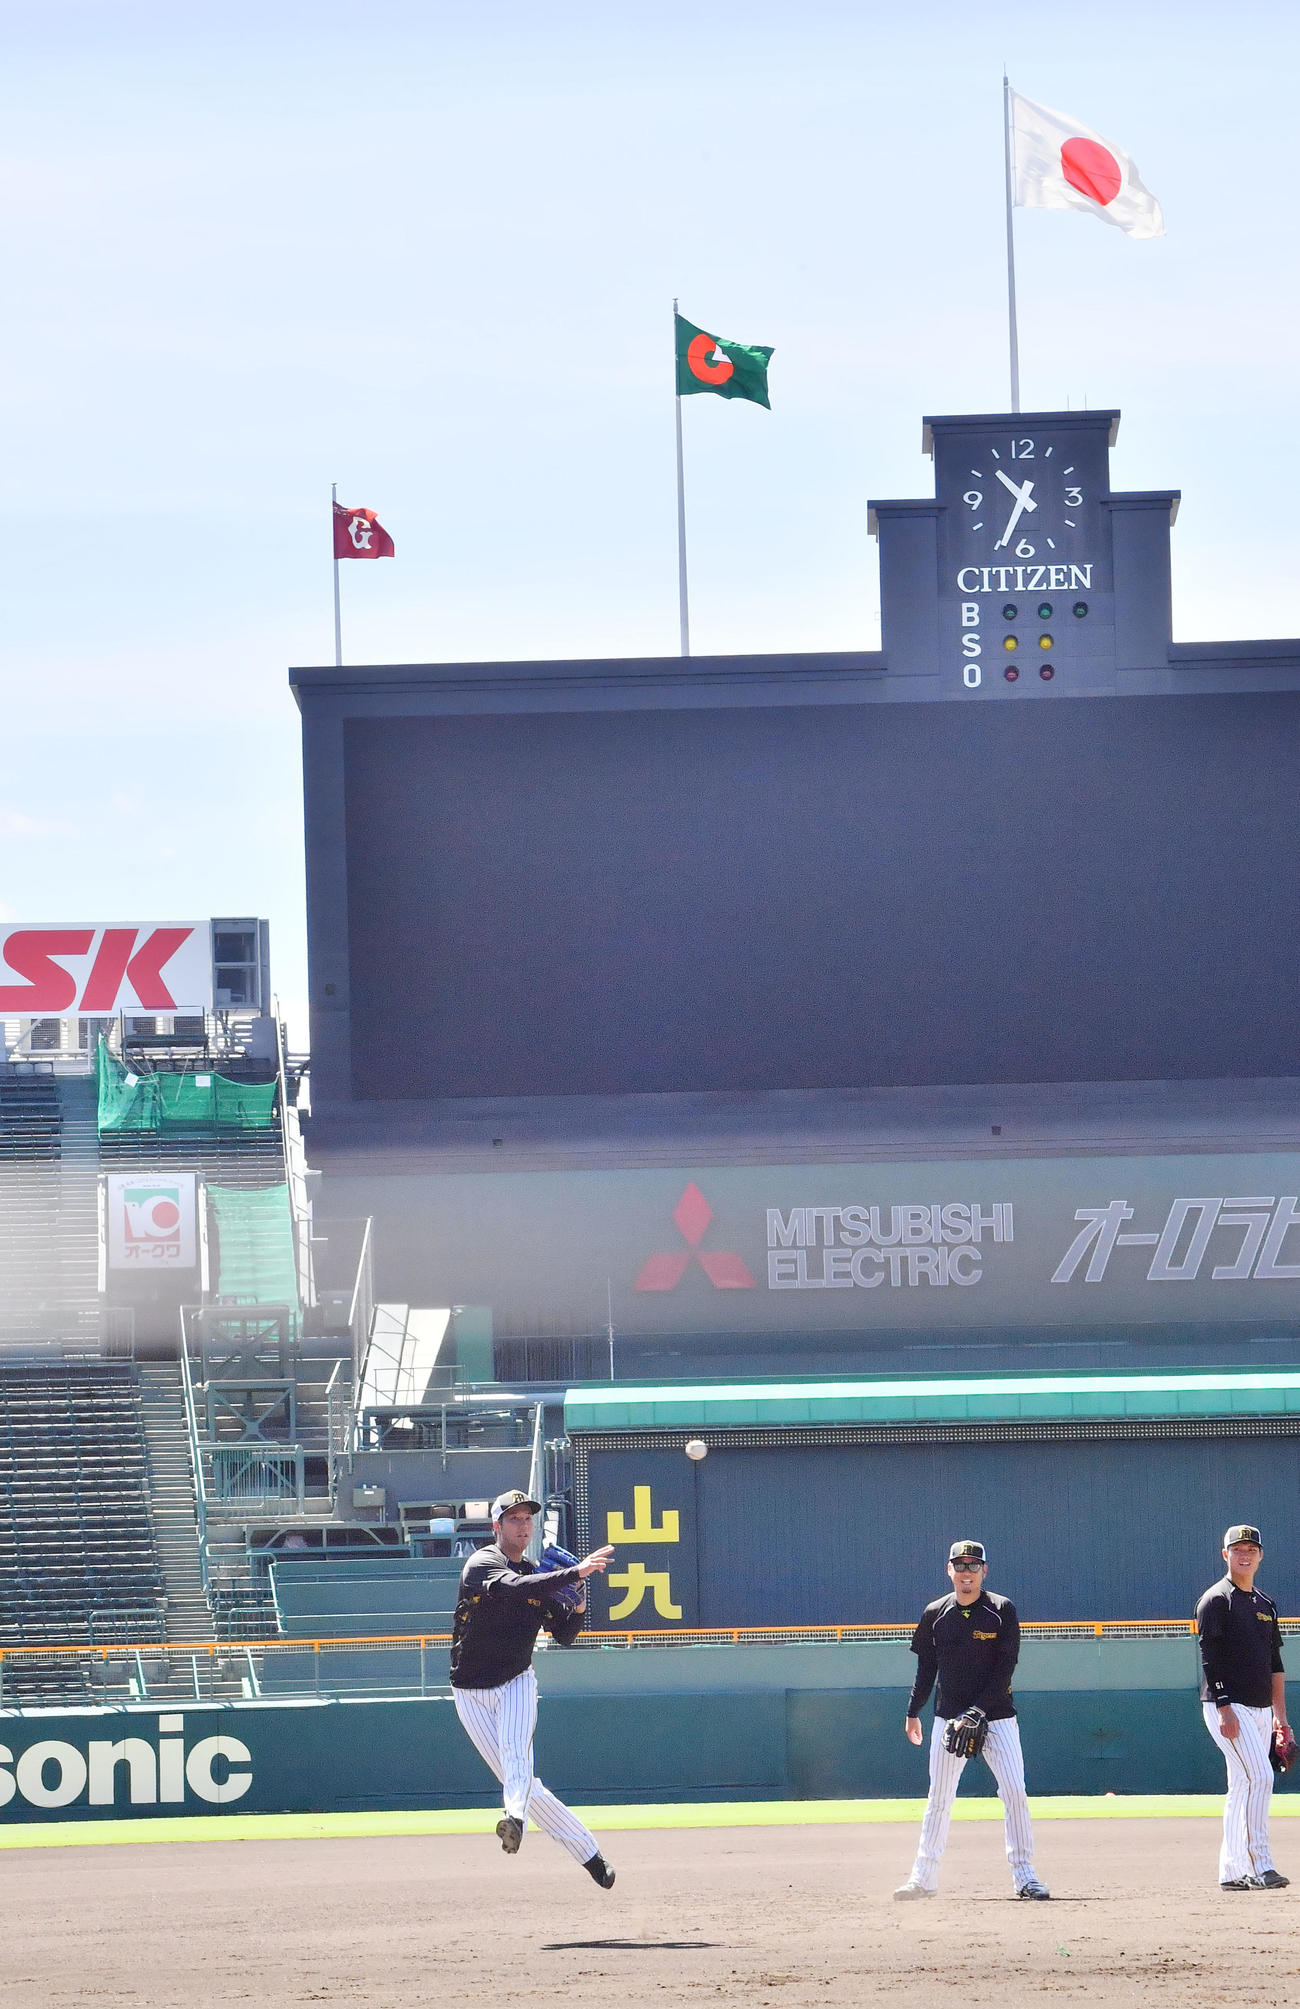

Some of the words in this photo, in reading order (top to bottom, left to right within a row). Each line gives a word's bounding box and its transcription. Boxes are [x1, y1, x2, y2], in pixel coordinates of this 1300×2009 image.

[1011, 439, 1035, 459] 12
[963, 491, 983, 511] 9
[1064, 487, 1083, 507] 3
[1015, 538, 1036, 558] 6
[957, 564, 1093, 593] CITIZEN
[962, 602, 980, 627] B
[962, 633, 982, 658] S
[0, 928, 195, 1012] SK
[766, 1203, 1014, 1247] MITSUBISHI
[124, 1244, 181, 1258] オークワ
[767, 1245, 983, 1289] ELECTRIC
[607, 1485, 683, 1621] 山九
[0, 1713, 253, 1808] onic
